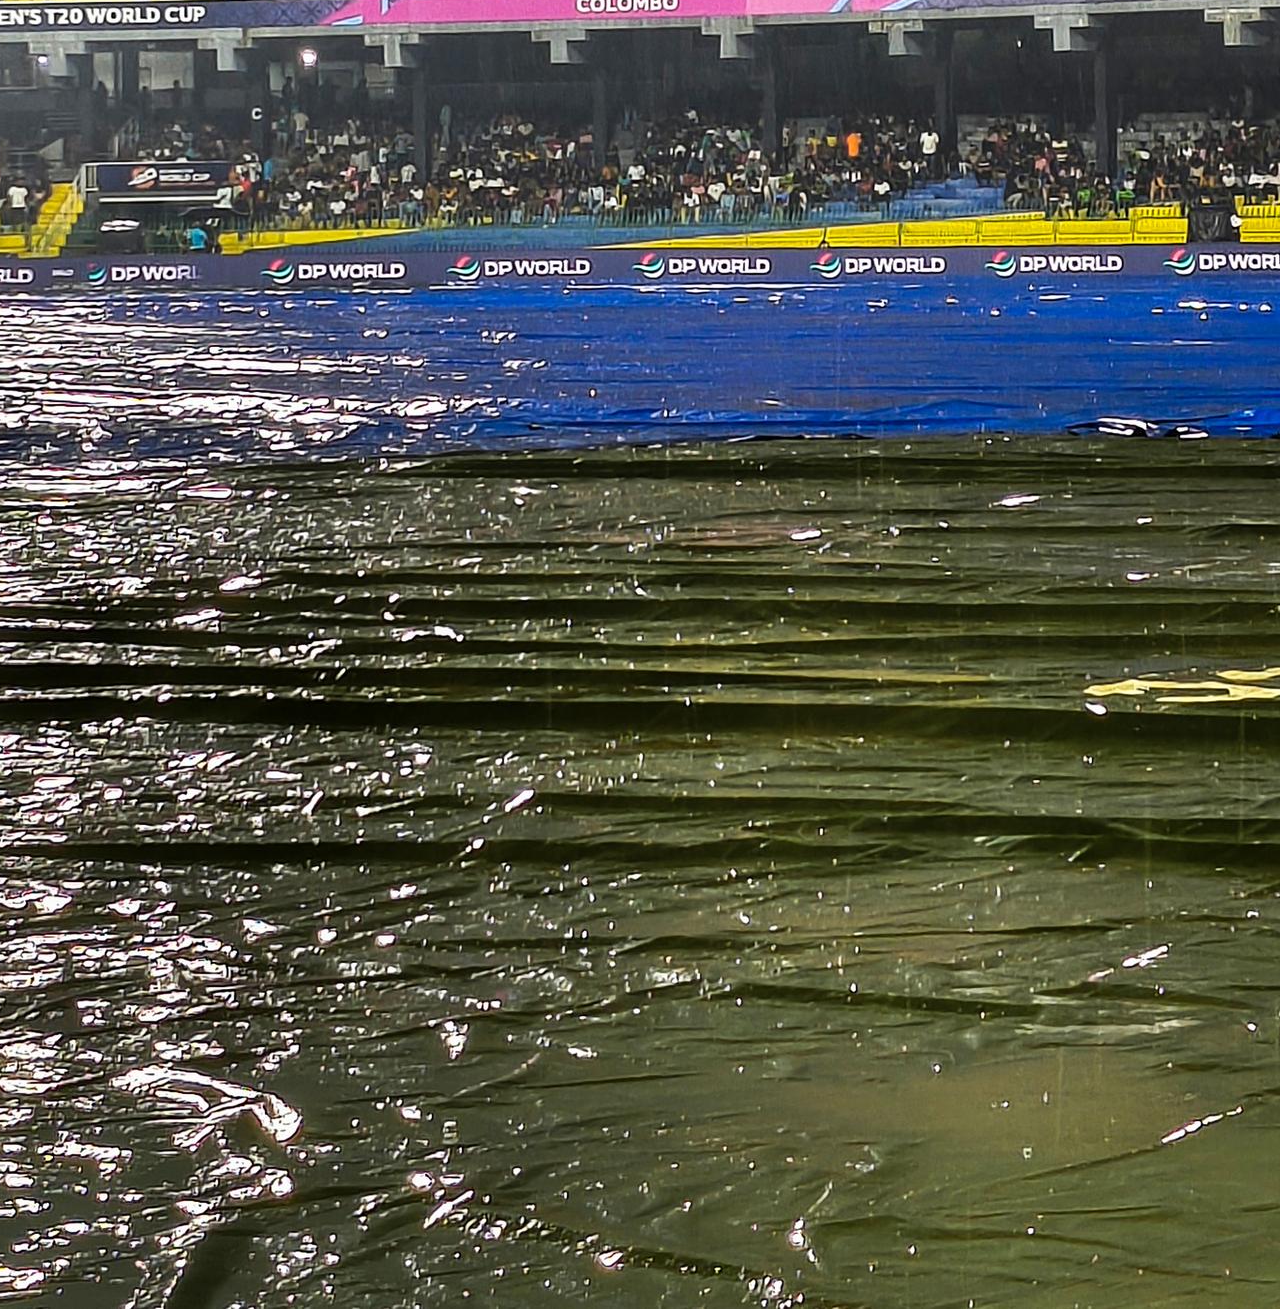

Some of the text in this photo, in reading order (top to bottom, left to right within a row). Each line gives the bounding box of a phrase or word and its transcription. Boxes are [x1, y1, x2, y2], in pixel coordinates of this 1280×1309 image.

[45, 8, 82, 24] T20
[86, 7, 161, 23] WORLD
[165, 6, 205, 22] CUP
[484, 259, 590, 276] DP WORLD
[668, 258, 770, 274] DP WORLD
[844, 257, 946, 274] DP WORLD
[1019, 255, 1123, 272] DP WORLD
[1199, 253, 1227, 270] DP
[111, 265, 200, 281] DP WORL
[298, 263, 405, 279] DP WORLD
